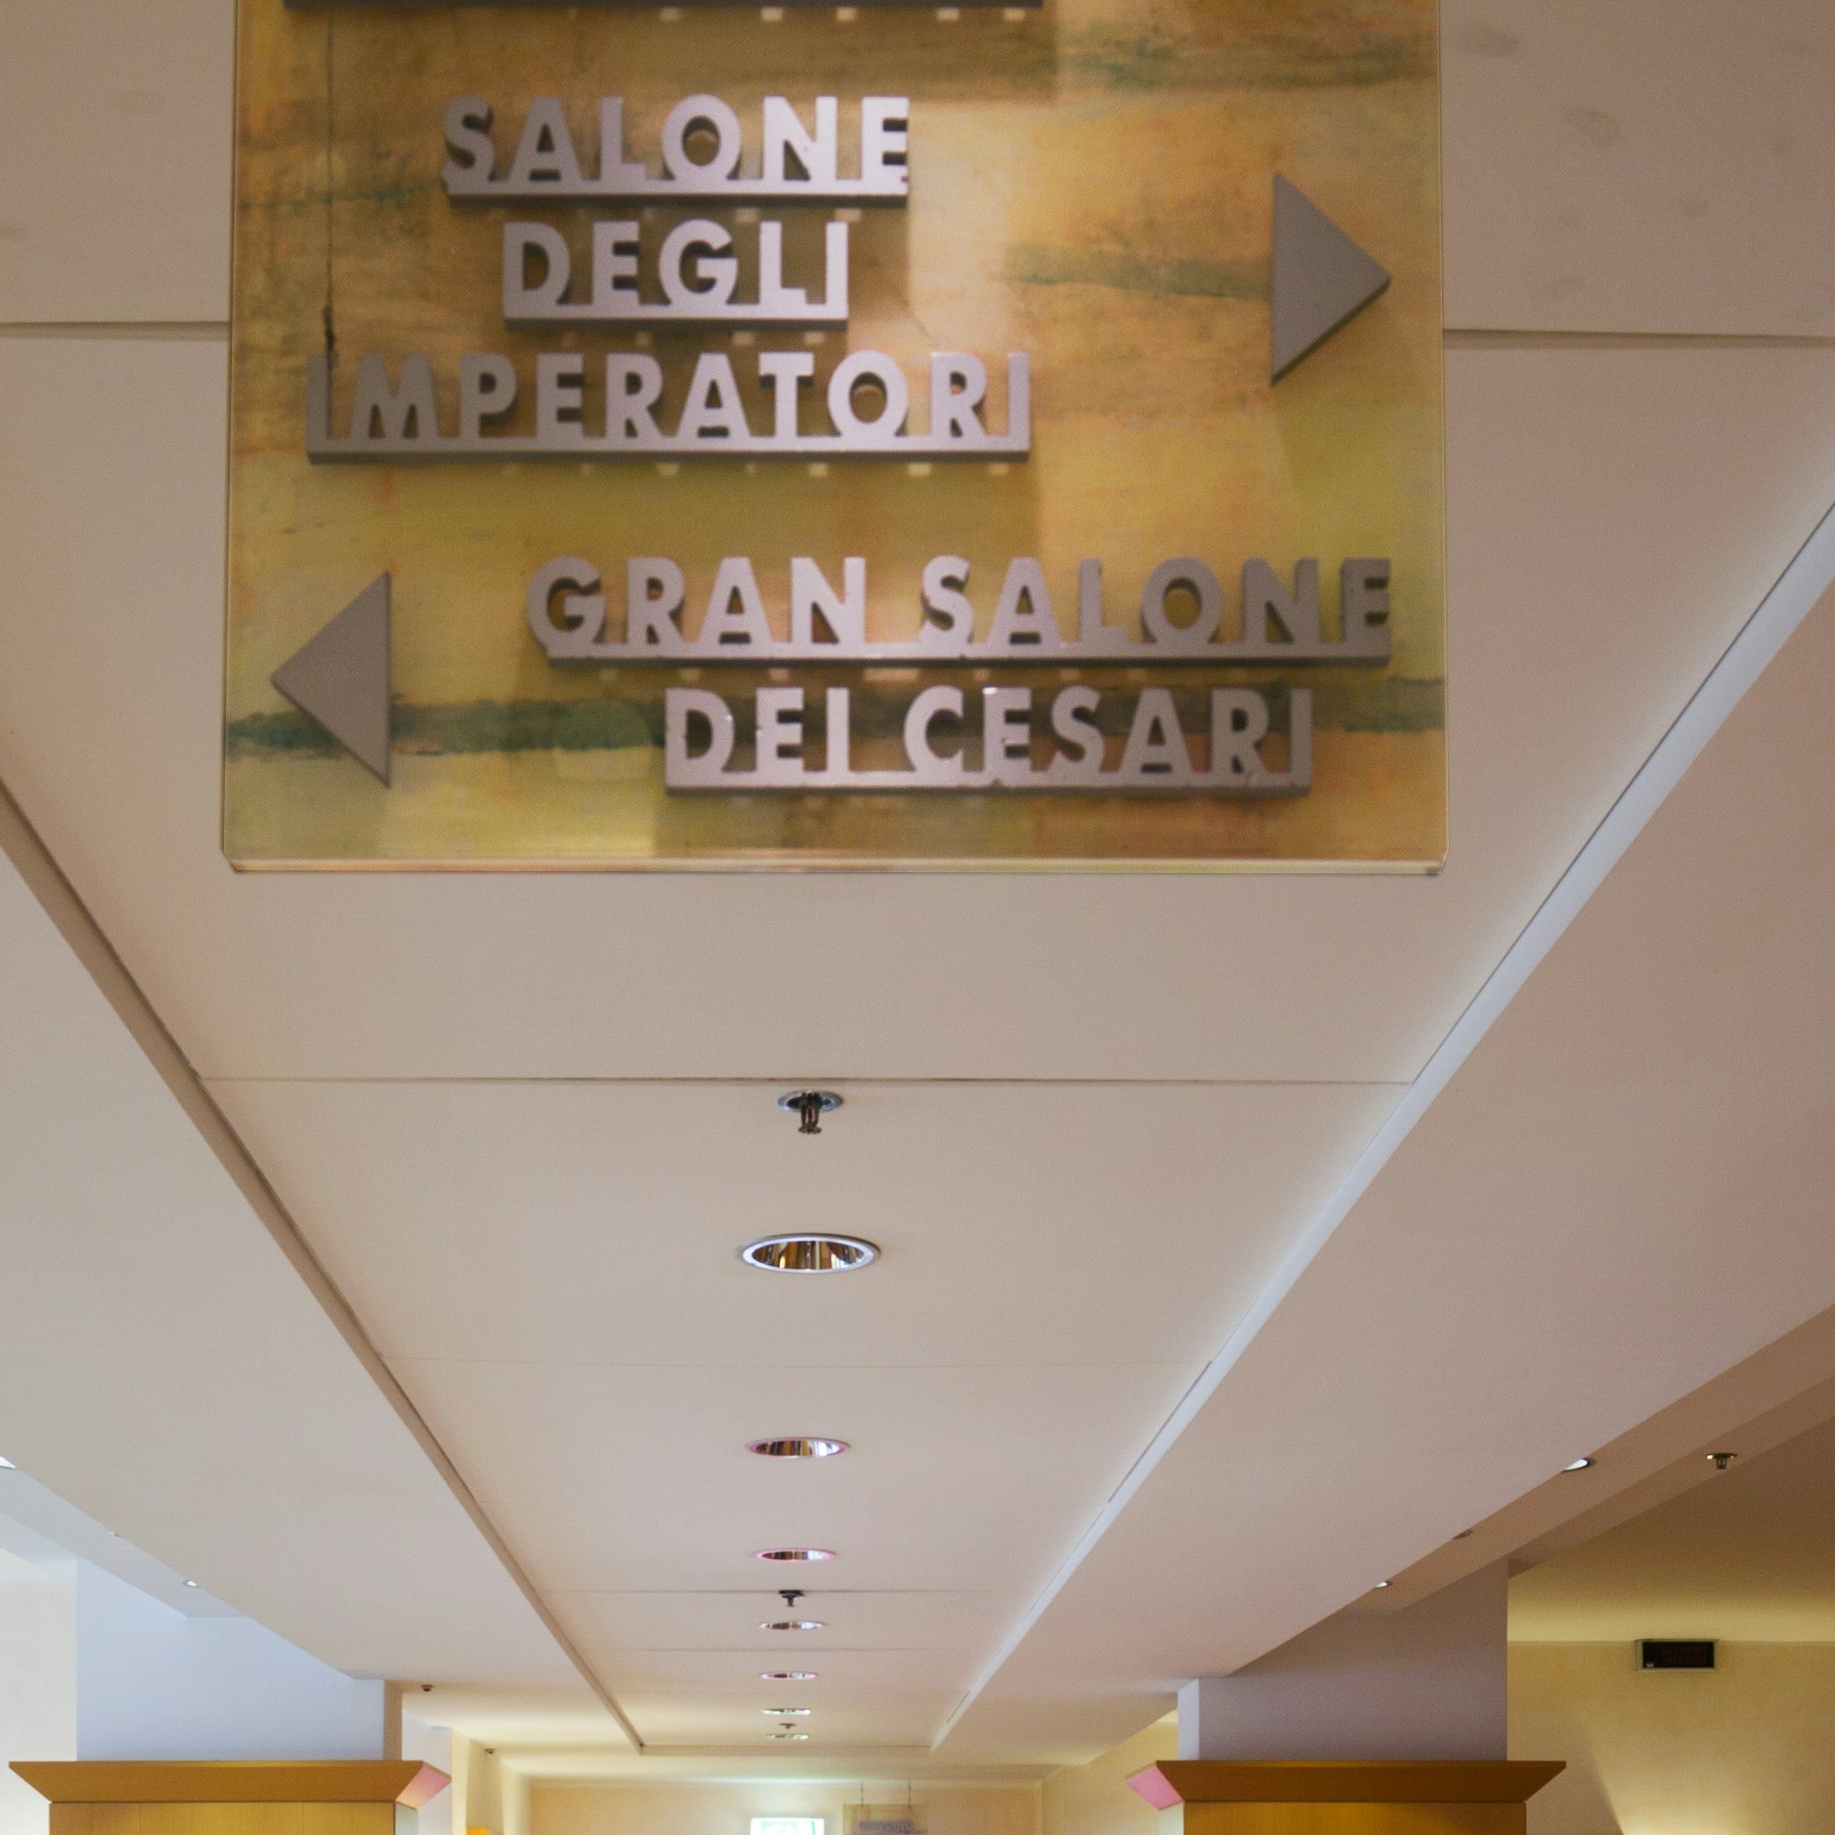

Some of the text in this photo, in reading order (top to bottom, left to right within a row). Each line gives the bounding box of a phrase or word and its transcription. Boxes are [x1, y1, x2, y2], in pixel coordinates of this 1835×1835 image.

[442, 94, 909, 195] SALONE
[504, 218, 848, 318] DEGLI
[306, 350, 1031, 451] IMPERATORI
[526, 556, 1391, 659] GRAN SALONE
[664, 686, 1313, 786] DEI CESARI
